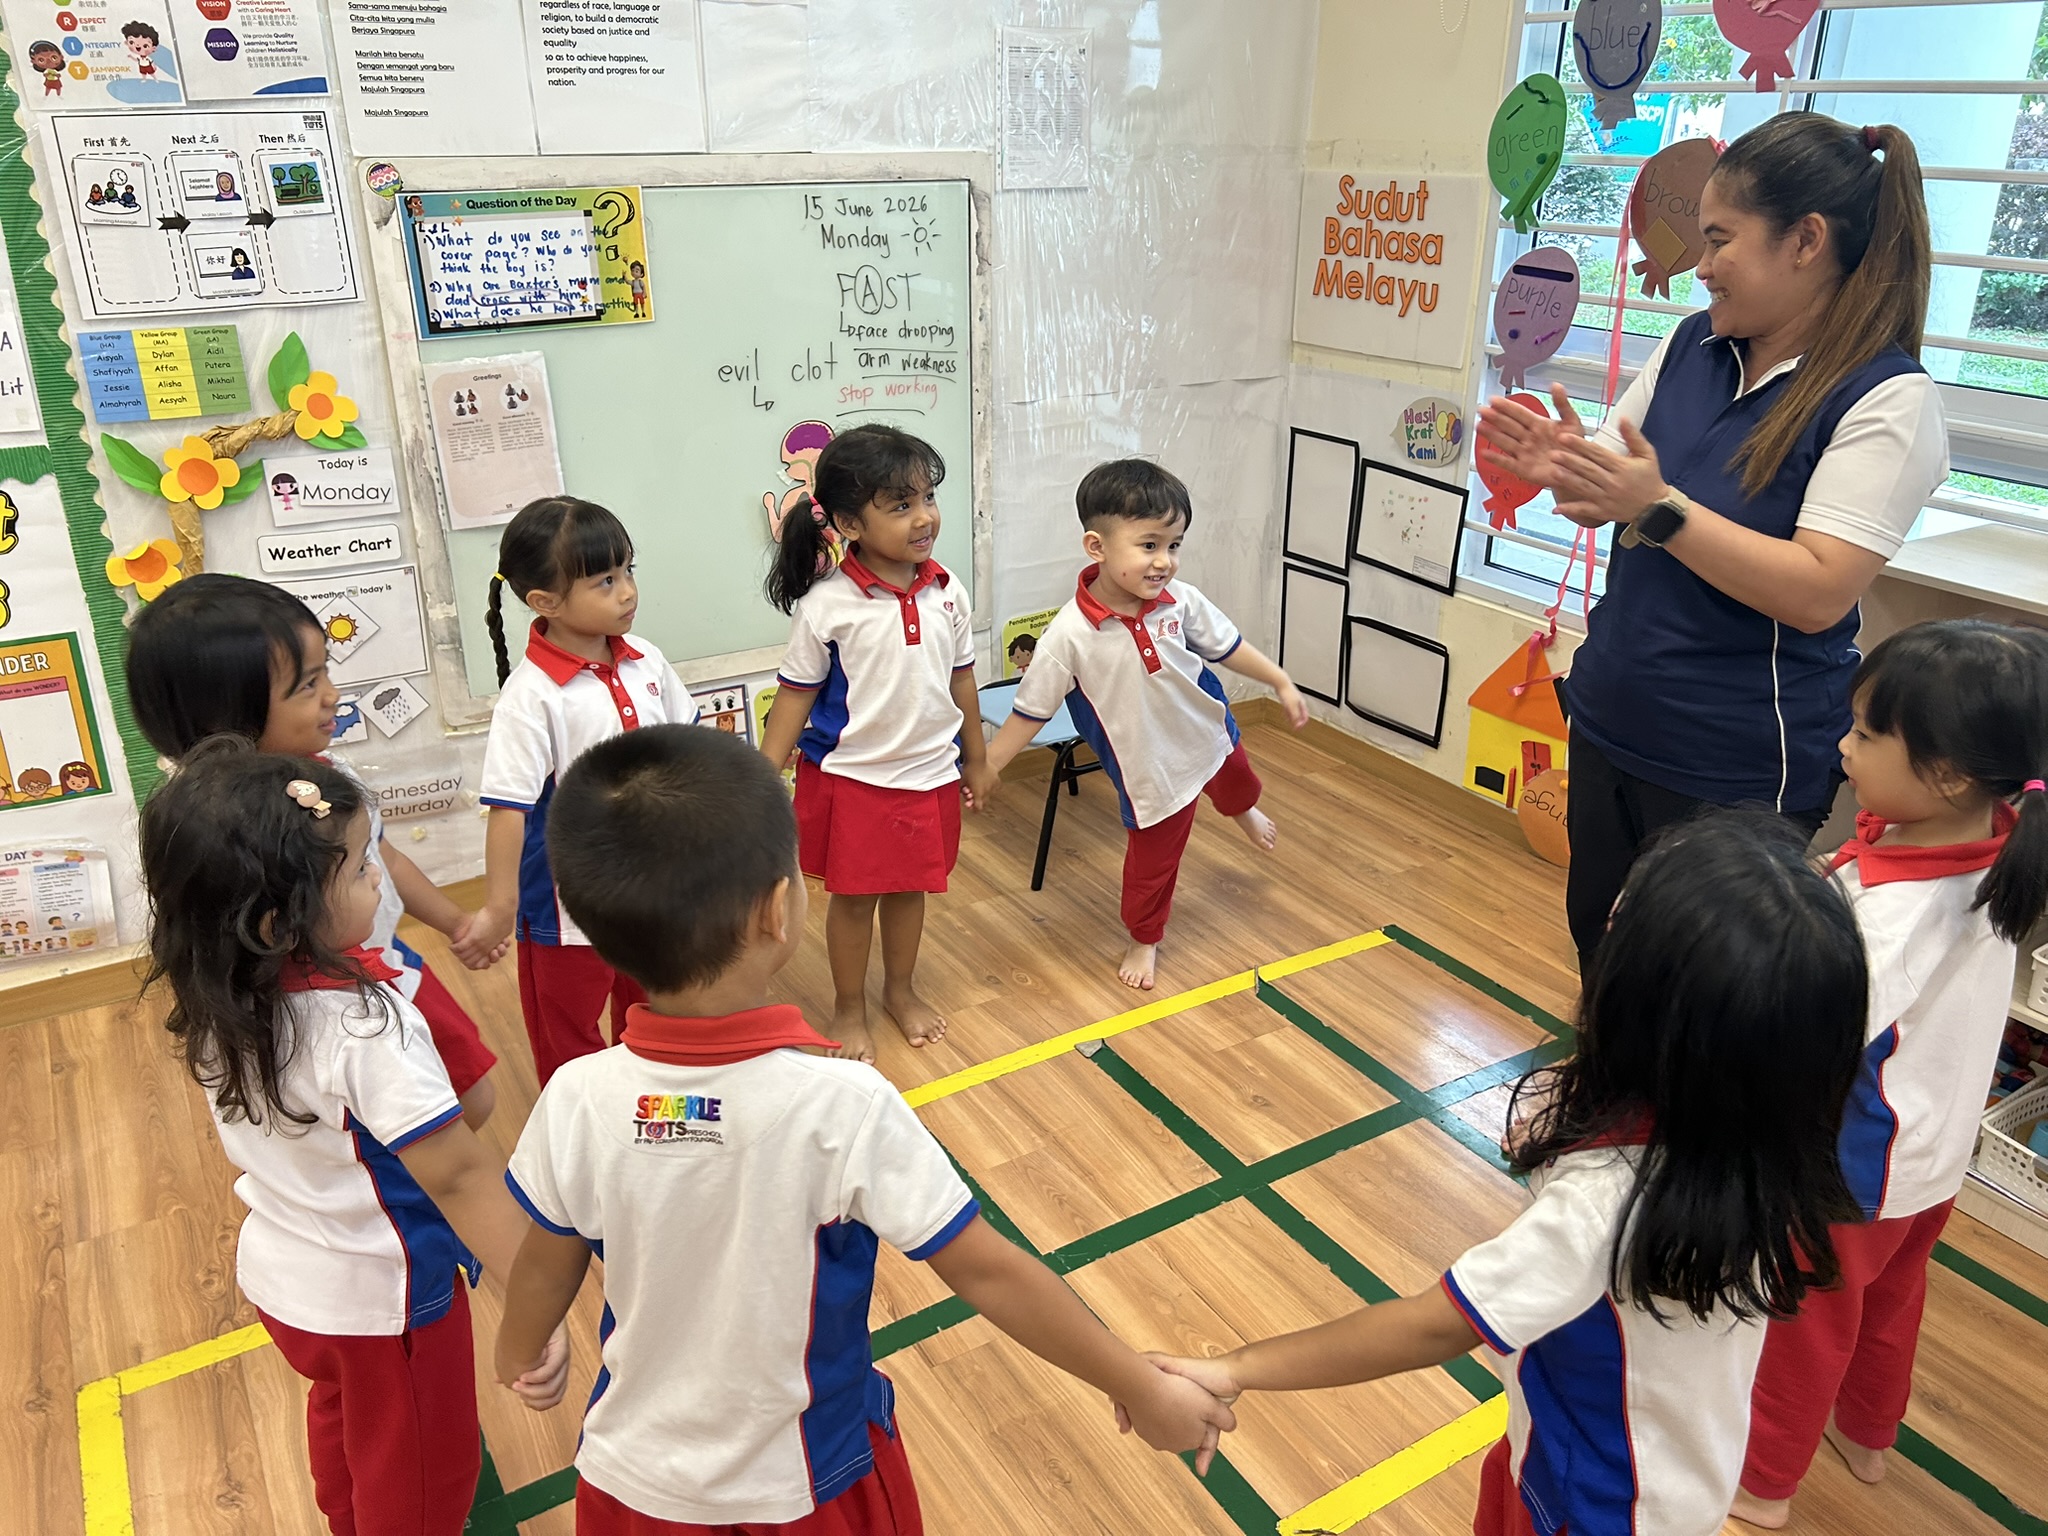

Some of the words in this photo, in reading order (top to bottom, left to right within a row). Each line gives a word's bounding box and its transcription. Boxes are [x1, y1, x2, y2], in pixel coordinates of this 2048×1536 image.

[419, 4, 447, 12] bahagia
[540, 1, 580, 9] regardless
[613, 2, 650, 11] language
[541, 14, 573, 22] religion,
[575, 14, 583, 22] to
[586, 14, 606, 22] build
[616, 15, 659, 24] democratic
[352, 26, 378, 34] Berjaya
[380, 27, 415, 35] Singapura
[542, 27, 569, 35] society
[609, 27, 632, 36] justice
[635, 28, 650, 36] and
[1589, 6, 1640, 51] blue
[543, 39, 577, 48] equality
[609, 54, 648, 63] happiness,
[357, 62, 384, 70] Dengan
[547, 66, 586, 75] prosperity
[640, 66, 650, 74] for
[84, 137, 105, 147] First
[107, 137, 131, 147] 首先
[172, 135, 196, 145] Next
[199, 134, 219, 144] 之后
[259, 134, 283, 143] Then
[287, 134, 306, 143] 然后
[1495, 124, 1559, 174] green
[1336, 175, 1428, 222] Sudut
[1644, 168, 1700, 218] brow
[467, 199, 518, 209] Question
[521, 197, 532, 207] of
[534, 197, 553, 206] the
[556, 196, 577, 207] Day
[805, 194, 823, 219] 15
[835, 198, 873, 218] June
[884, 195, 927, 213] 2026
[436, 232, 473, 247] What
[488, 231, 502, 245] do
[511, 231, 531, 249] you
[821, 224, 890, 258] Monday
[1324, 217, 1443, 265] Bahasa
[441, 251, 472, 260] cover
[536, 245, 556, 255] Who
[564, 245, 572, 254] do
[581, 244, 601, 257] you
[206, 255, 225, 265] 你好
[440, 262, 471, 273] think
[480, 264, 498, 273] the
[506, 261, 525, 277] boy
[445, 281, 472, 297] Why
[483, 281, 500, 290] are
[837, 273, 921, 311] FAST
[1313, 259, 1439, 317] Melayu
[445, 293, 470, 305] dad
[1503, 277, 1562, 319] purple
[443, 307, 480, 319] What
[491, 306, 520, 318] does
[529, 303, 543, 313] he
[854, 324, 887, 342] face
[898, 320, 954, 347] drooping
[97, 354, 123, 362] Aisyah
[152, 351, 174, 359] Dylan
[859, 353, 889, 367] arm
[718, 348, 759, 382] evil
[791, 342, 838, 381] clot
[93, 368, 134, 376] Shafiyyah
[473, 373, 502, 381] Greetings
[104, 384, 130, 392] Jessie
[100, 399, 142, 409] Almahyrah
[1404, 402, 1436, 424] Hasil
[1405, 424, 1434, 441] Kraf
[1407, 443, 1436, 461] Kami
[318, 458, 354, 470] Today
[358, 456, 367, 466] is
[303, 484, 391, 503] Monday
[268, 544, 341, 560] Weather
[348, 538, 392, 553] Chart
[360, 585, 383, 594] today
[1009, 613, 1046, 626] Pendengaran
[1030, 621, 1048, 629] Badan
[381, 797, 454, 817] aturday
[5, 851, 27, 861] DAY
[636, 1094, 721, 1121] SPARKLE
